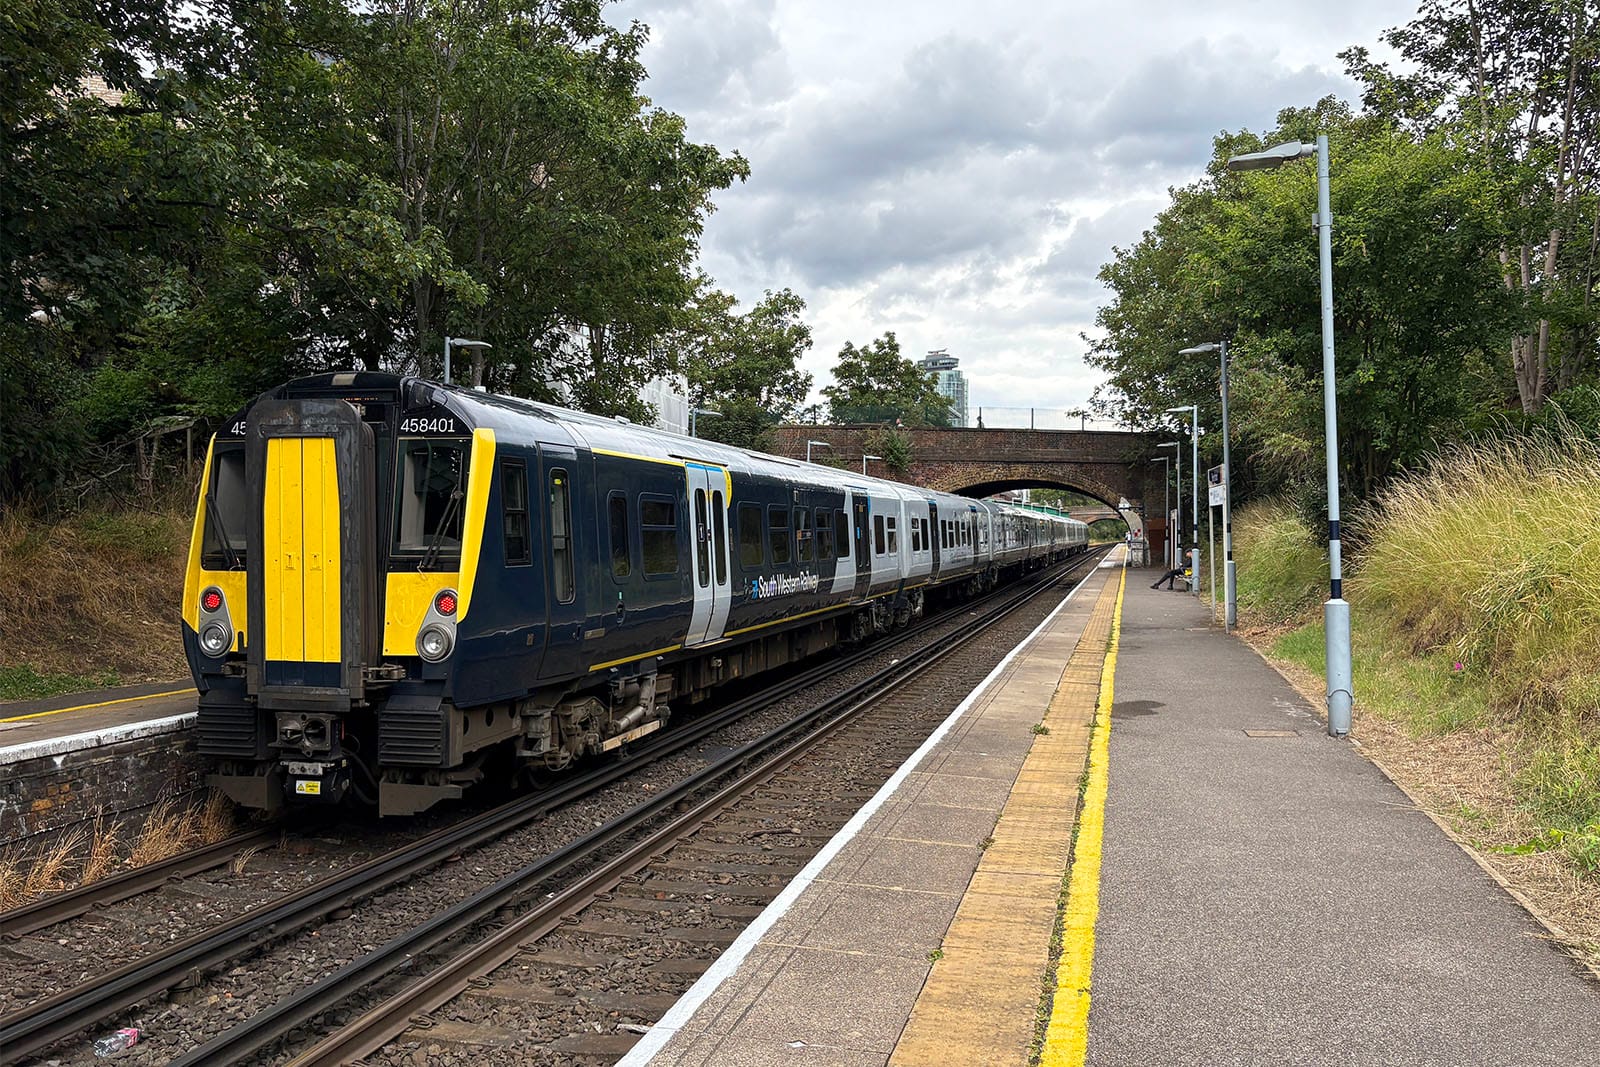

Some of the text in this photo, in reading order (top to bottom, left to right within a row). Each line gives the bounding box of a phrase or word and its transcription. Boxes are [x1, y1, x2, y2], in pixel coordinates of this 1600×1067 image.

[400, 418, 455, 433] 458401
[758, 570, 819, 599] South Western Railway
